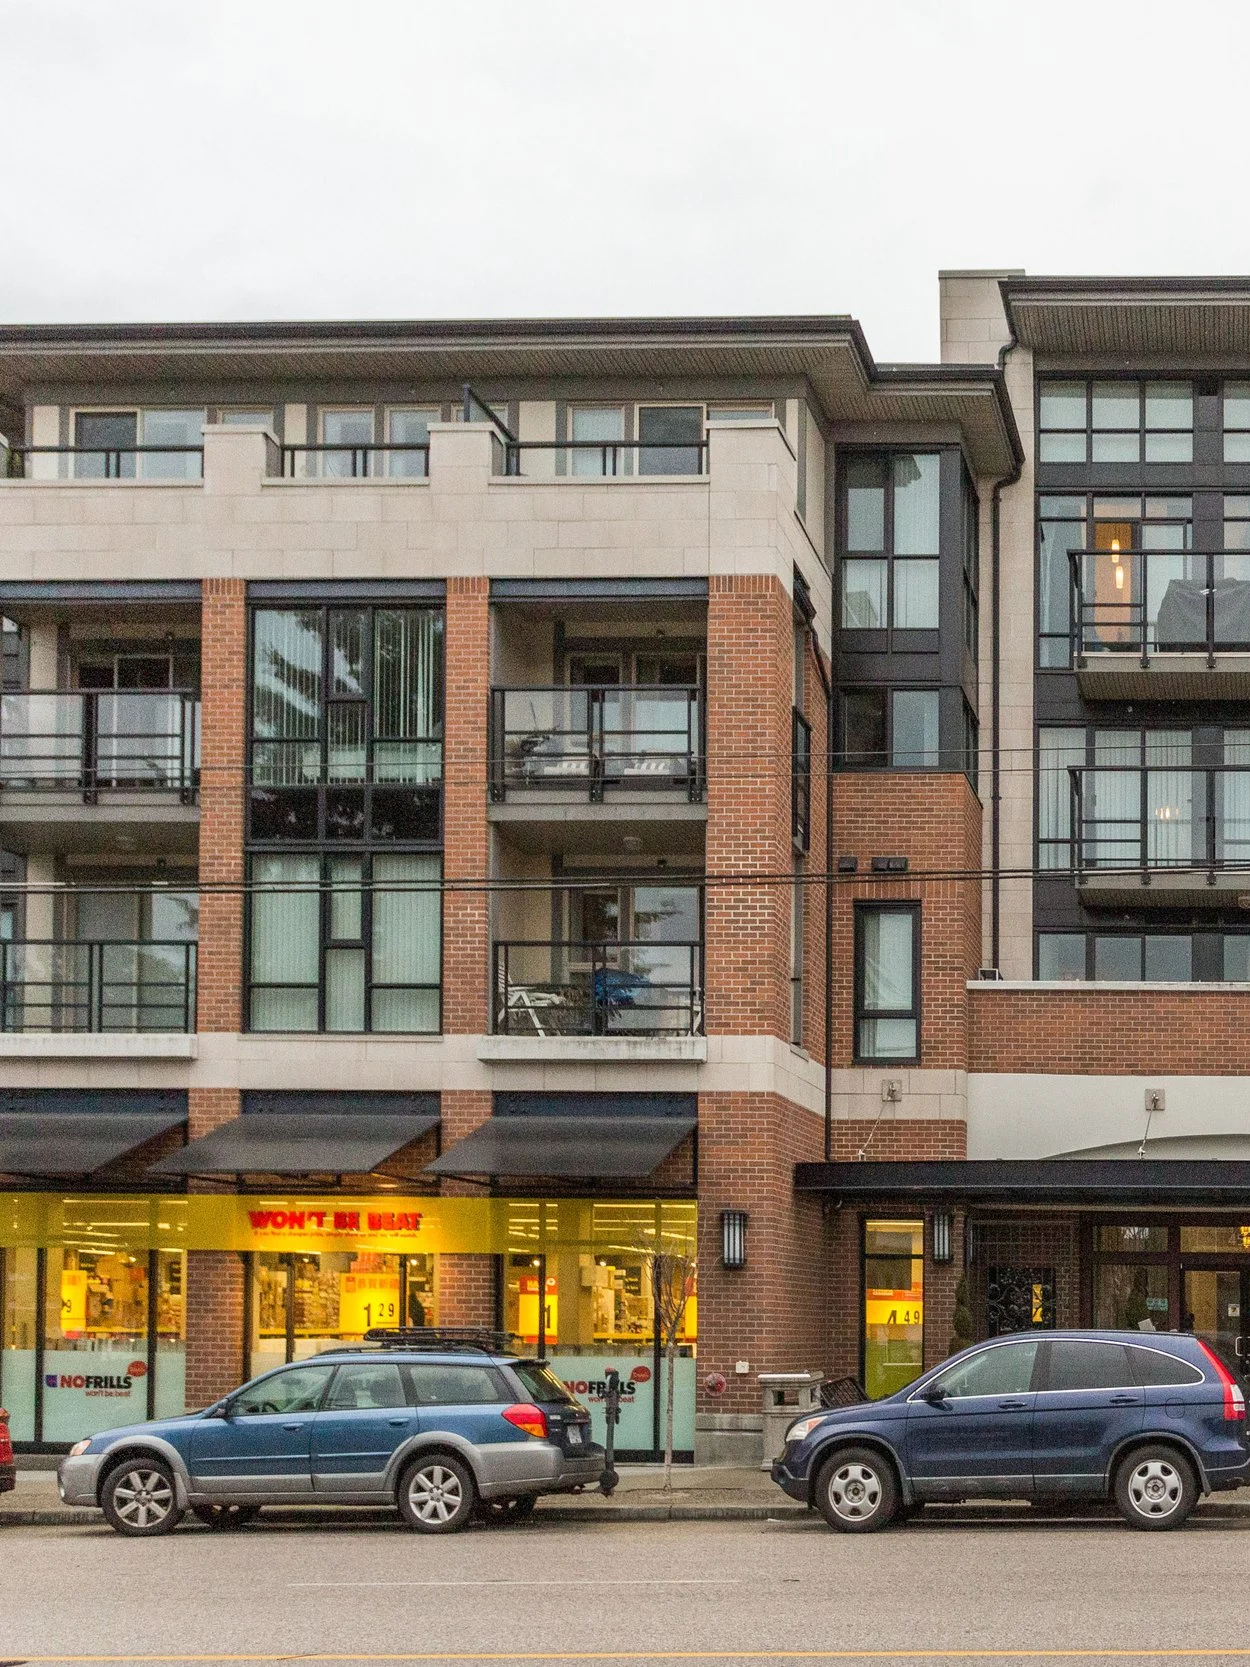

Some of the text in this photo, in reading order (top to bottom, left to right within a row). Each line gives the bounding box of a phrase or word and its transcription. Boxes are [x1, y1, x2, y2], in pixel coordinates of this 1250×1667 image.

[248, 1210, 422, 1231] WON'T BE BEAT
[60, 1375, 132, 1389] NOFRILLS
